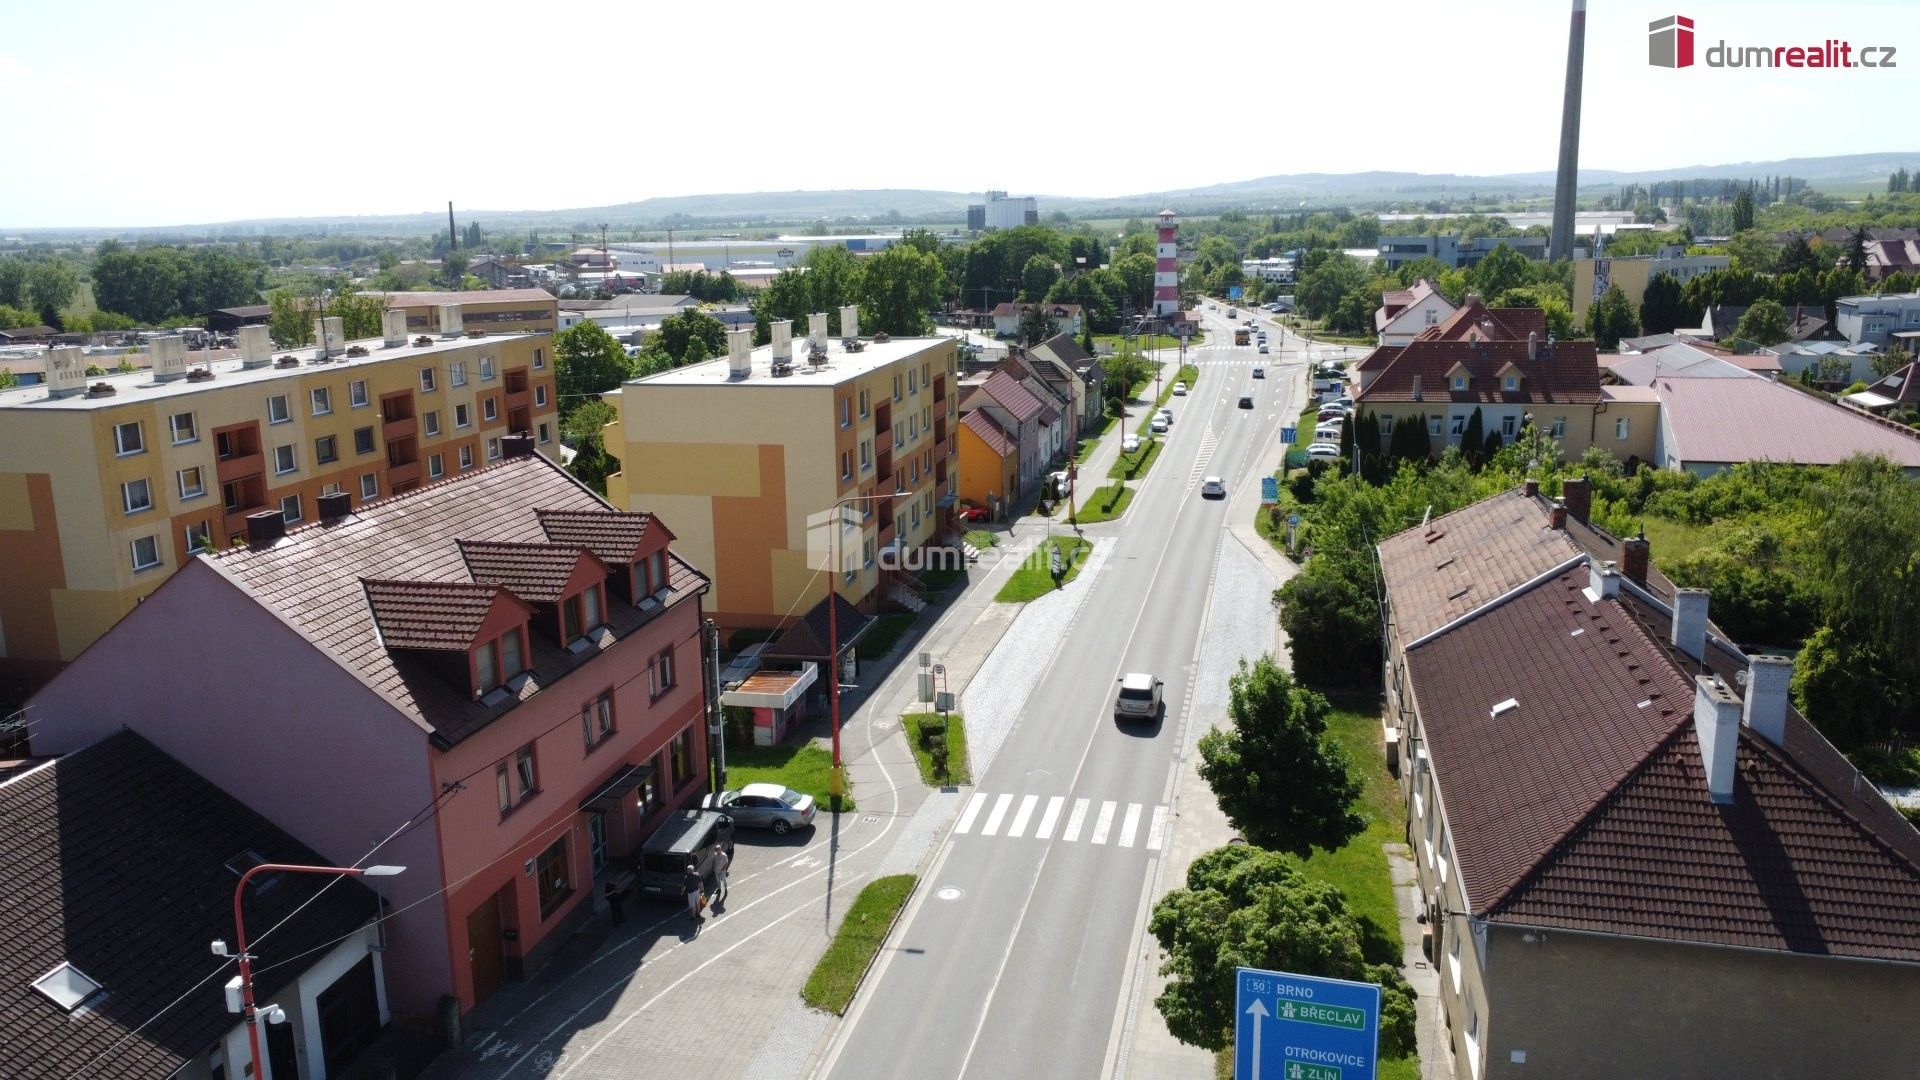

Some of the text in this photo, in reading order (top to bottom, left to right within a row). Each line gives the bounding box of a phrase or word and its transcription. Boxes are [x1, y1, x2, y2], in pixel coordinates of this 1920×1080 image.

[1253, 982, 1313, 998] 50 BRNO
[1300, 1006, 1360, 1025] BŘECLAV
[1285, 1046, 1365, 1067] OTROKOVICE
[1308, 1068, 1337, 1080] ZLÍN
